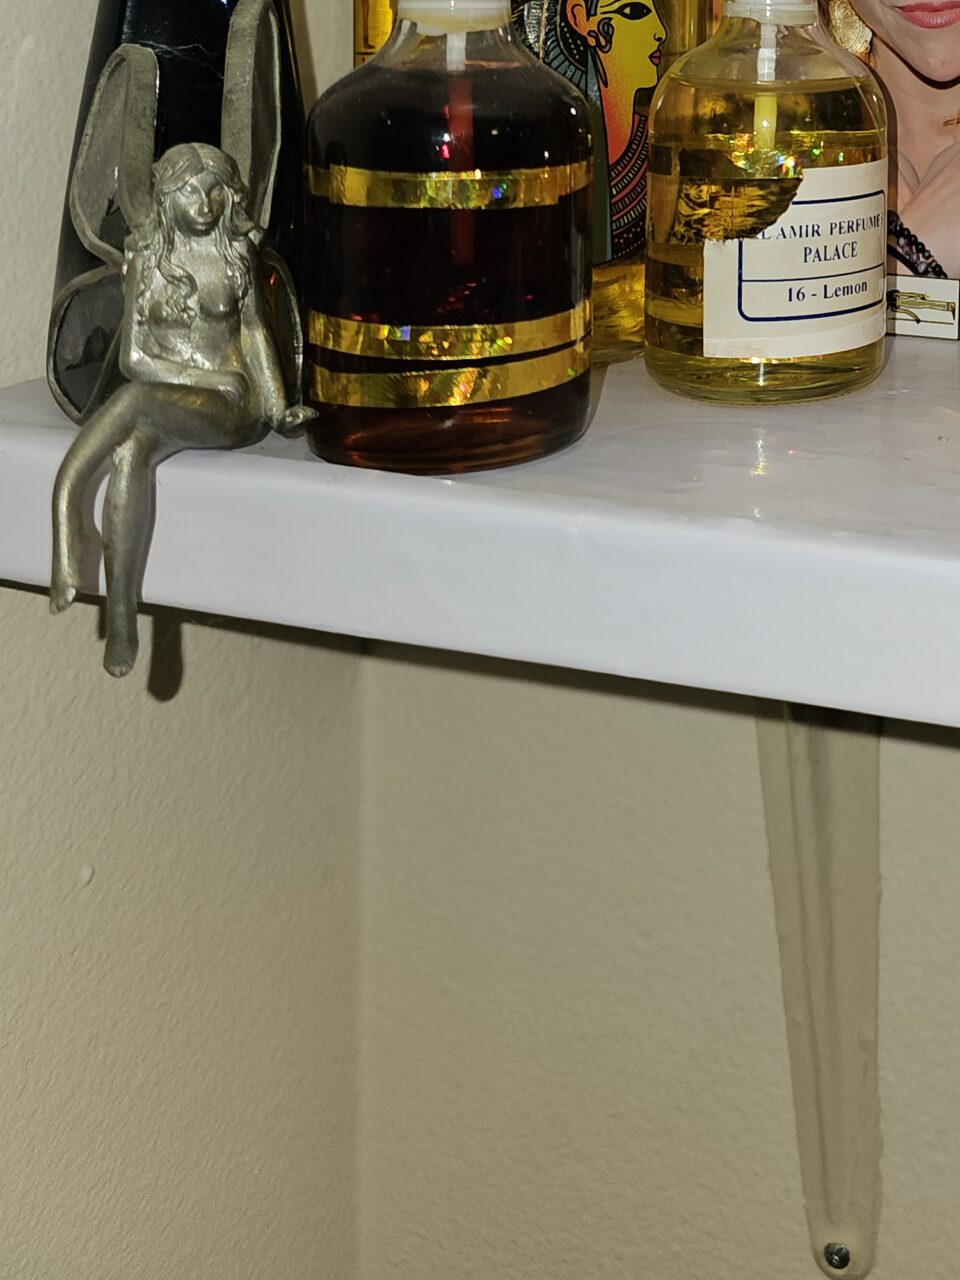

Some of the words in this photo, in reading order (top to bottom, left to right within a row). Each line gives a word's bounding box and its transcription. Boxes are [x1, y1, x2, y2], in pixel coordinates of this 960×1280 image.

[776, 224, 821, 240] AMIR
[803, 241, 858, 263] PALACE
[788, 287, 806, 302] 16
[823, 281, 868, 299] Lemon
